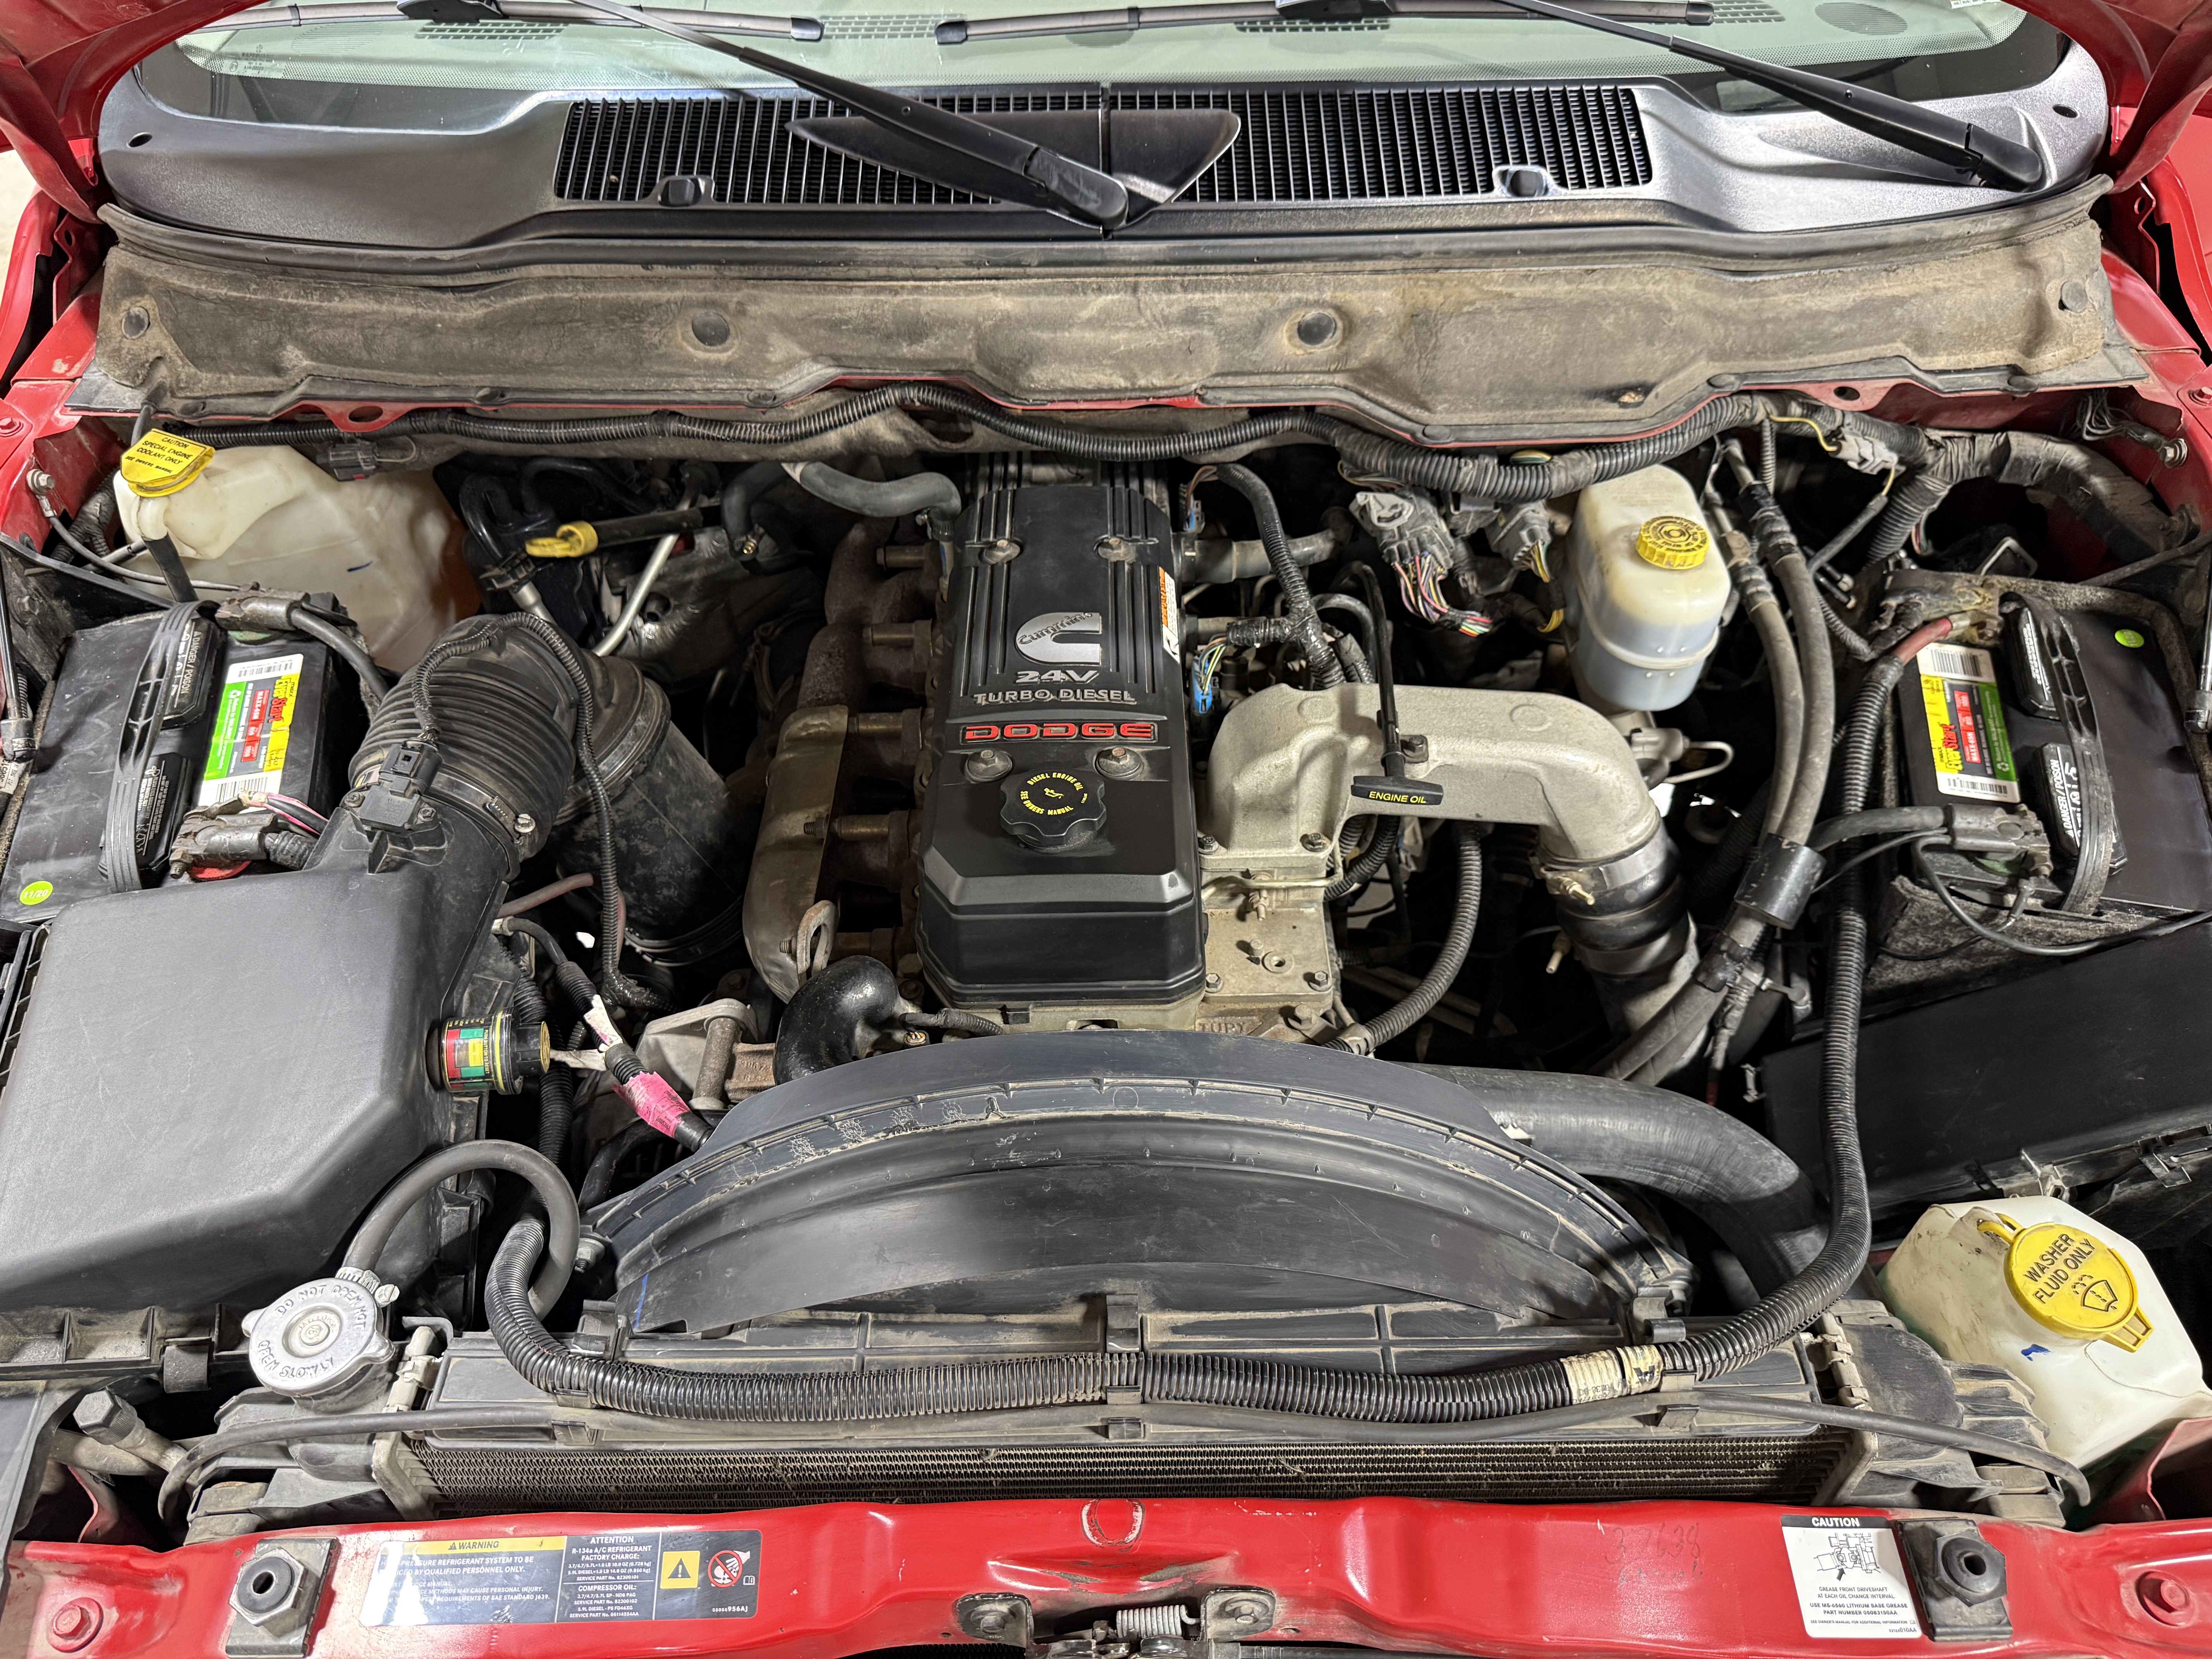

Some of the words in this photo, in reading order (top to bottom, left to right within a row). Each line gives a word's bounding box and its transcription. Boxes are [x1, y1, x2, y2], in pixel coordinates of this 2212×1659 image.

[162, 437, 189, 448] CAUTION
[137, 448, 164, 460] COOLANT
[165, 456, 183, 464] ONLY
[143, 441, 167, 452] SPECIAL
[167, 448, 193, 460] ENGINE
[187, 638, 200, 664] DANGER
[181, 669, 193, 694] POISON
[1015, 670, 1099, 684] 24V
[974, 689, 1052, 706] TURBO
[1059, 689, 1137, 704] DIESEL
[965, 723, 1152, 739] DODGE
[1027, 773, 1050, 785] DIESEL
[1053, 773, 1077, 783] ENGINE
[1074, 782, 1083, 790] OIL
[2050, 759, 2064, 789] POISON
[1020, 791, 1029, 800] SEE
[1369, 791, 1408, 802] ENGINE
[1023, 800, 1044, 814] OWNERS
[1048, 806, 1073, 815] MANUAL
[2057, 796, 2072, 829] DANGER
[24, 889, 48, 899] 11/20
[2023, 1233, 2075, 1282] WASHER
[2033, 1269, 2069, 1304] FLUID
[2064, 1238, 2096, 1271] ONLY
[275, 1299, 294, 1316] DO
[298, 1285, 326, 1301] NOT
[1812, 1517, 1860, 1527] CAUTION
[459, 1541, 499, 1549] WARNING
[590, 1536, 634, 1544] ATTENTION
[438, 1558, 484, 1566] REFRIGERANT
[463, 1566, 504, 1574] PERSONNEL
